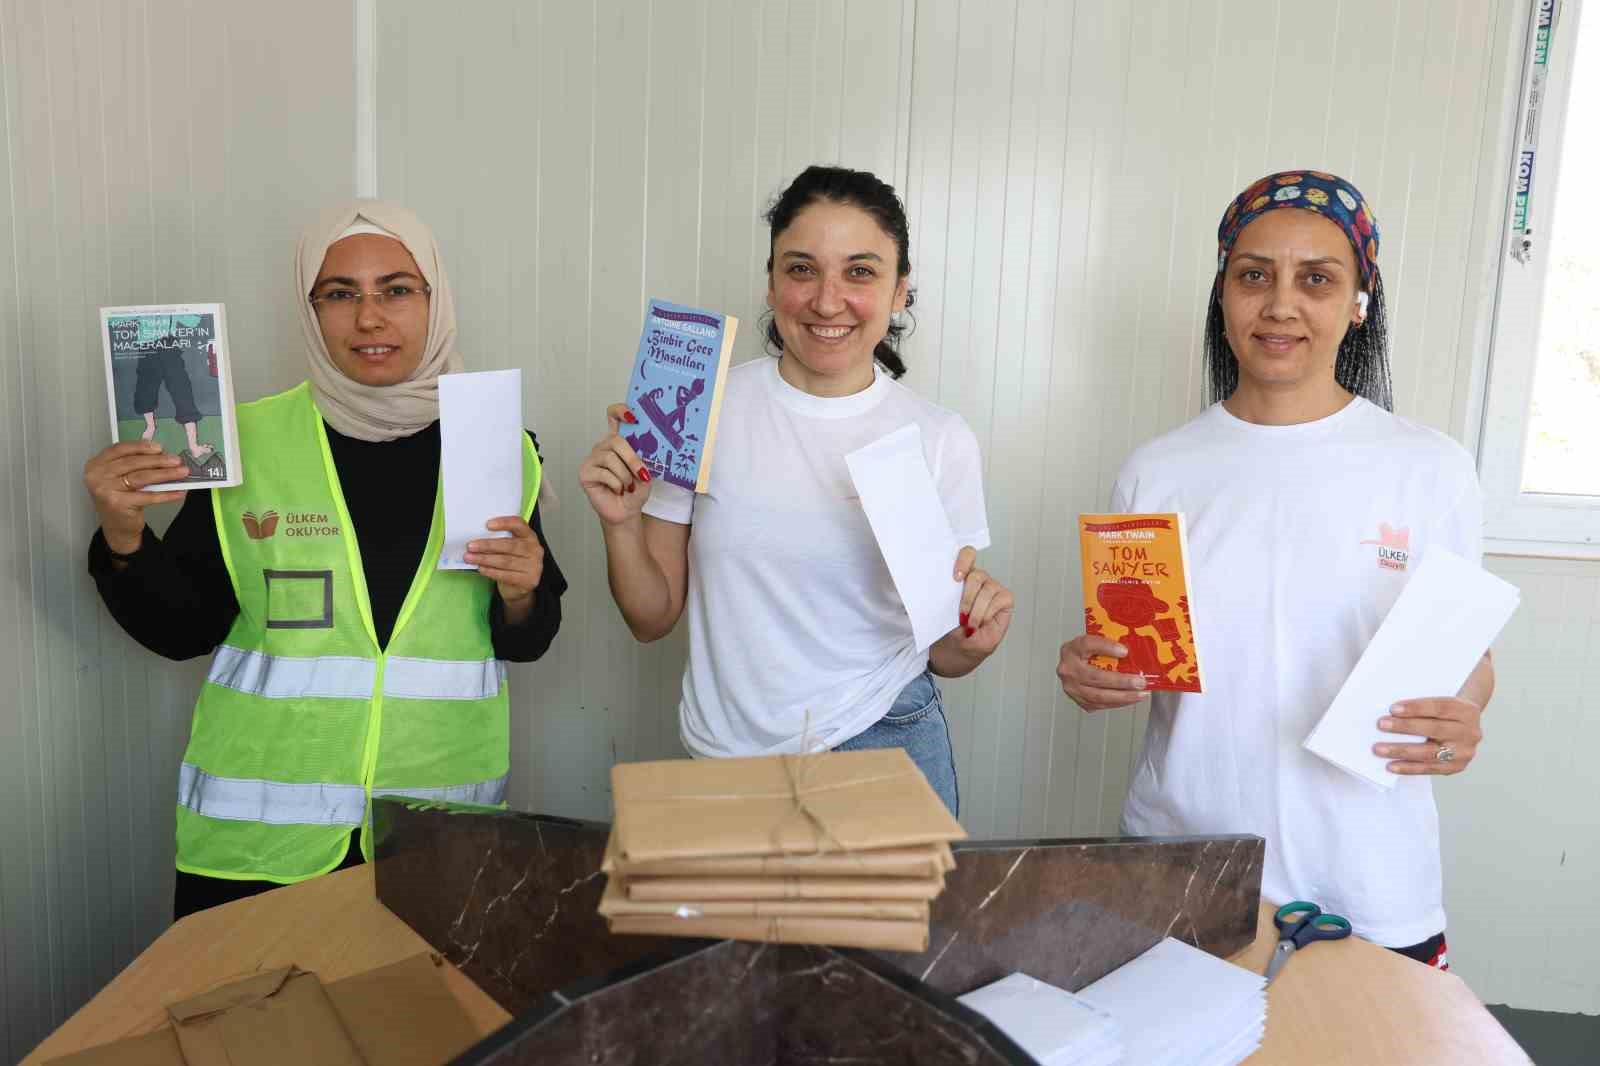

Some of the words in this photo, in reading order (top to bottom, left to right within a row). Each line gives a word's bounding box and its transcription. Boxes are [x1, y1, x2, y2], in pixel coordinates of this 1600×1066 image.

[113, 329, 140, 341] TOM
[113, 339, 192, 351] MACERALARI
[286, 512, 328, 524] ÜLKEM
[286, 527, 339, 537] OKUYOR
[1098, 530, 1123, 540] MARK
[1125, 530, 1155, 540] TWAIN
[1108, 546, 1148, 560] TOM
[1092, 560, 1170, 577] SAWYER
